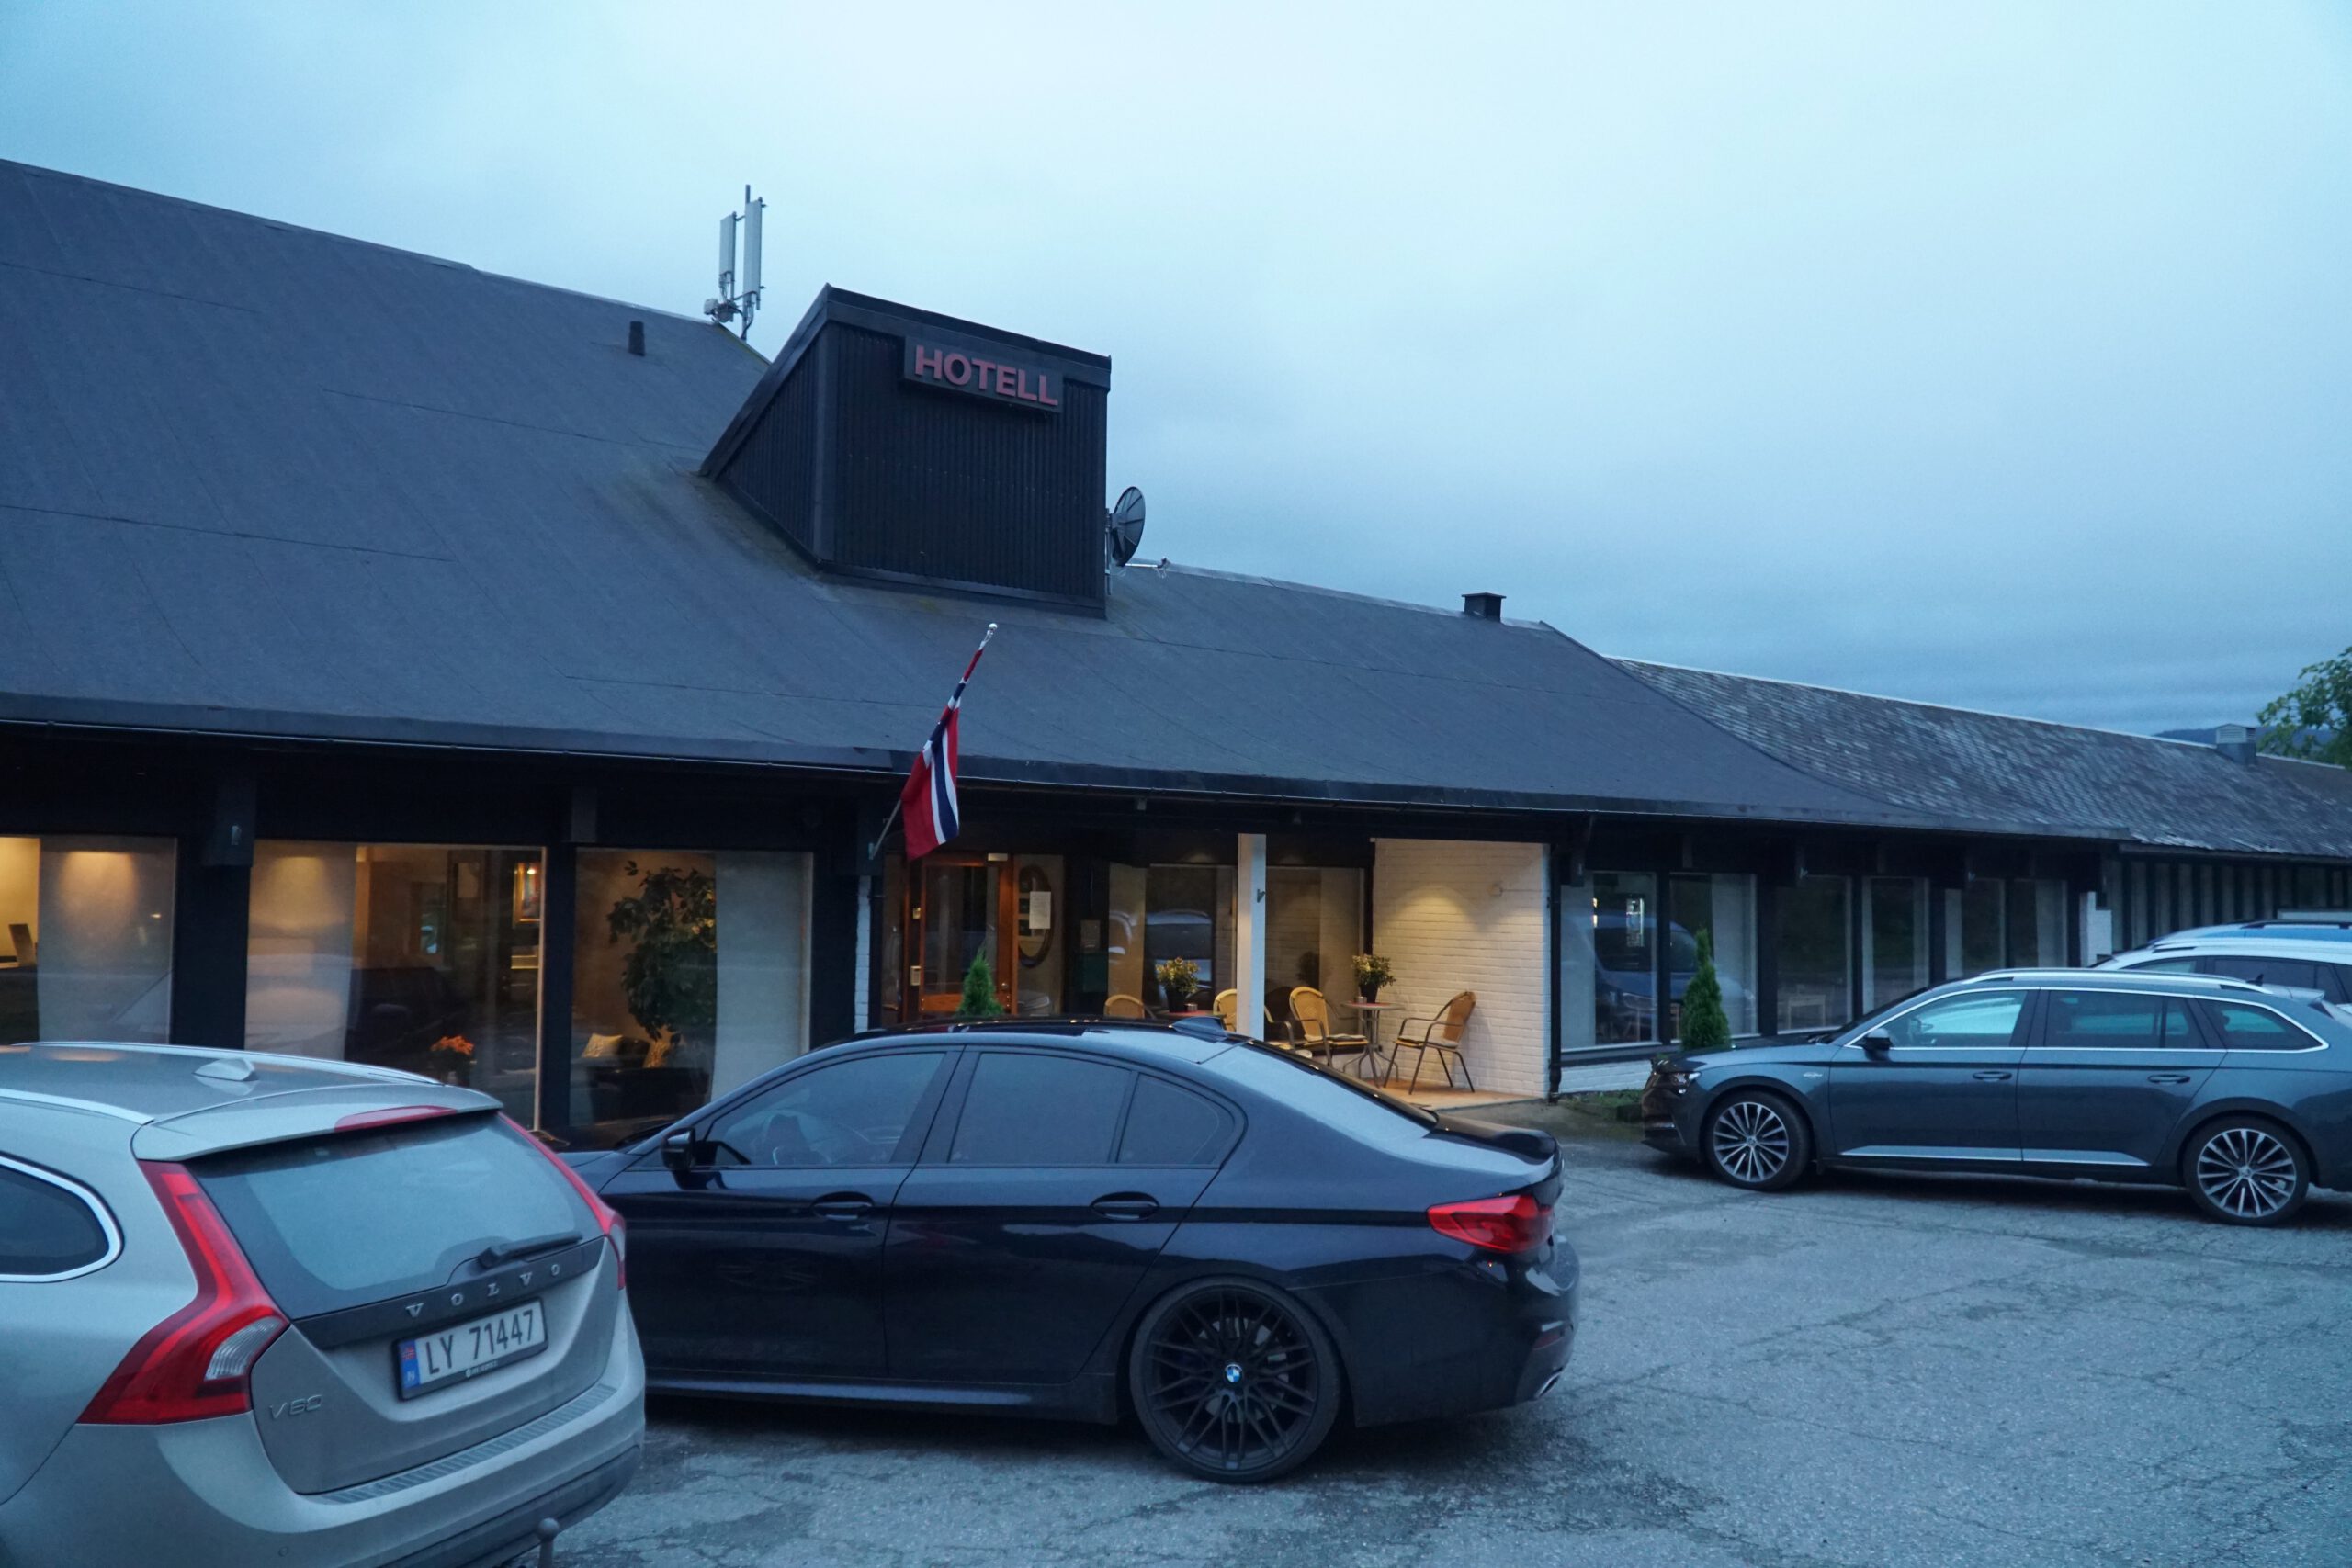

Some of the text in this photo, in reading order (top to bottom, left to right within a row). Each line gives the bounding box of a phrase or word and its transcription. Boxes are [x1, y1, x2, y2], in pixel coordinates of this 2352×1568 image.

[914, 344, 1059, 406] HOTELL
[405, 1263, 560, 1318] VOLVO
[425, 1334, 454, 1375] LY
[469, 1309, 534, 1360] 71447
[269, 1394, 322, 1419] V60
